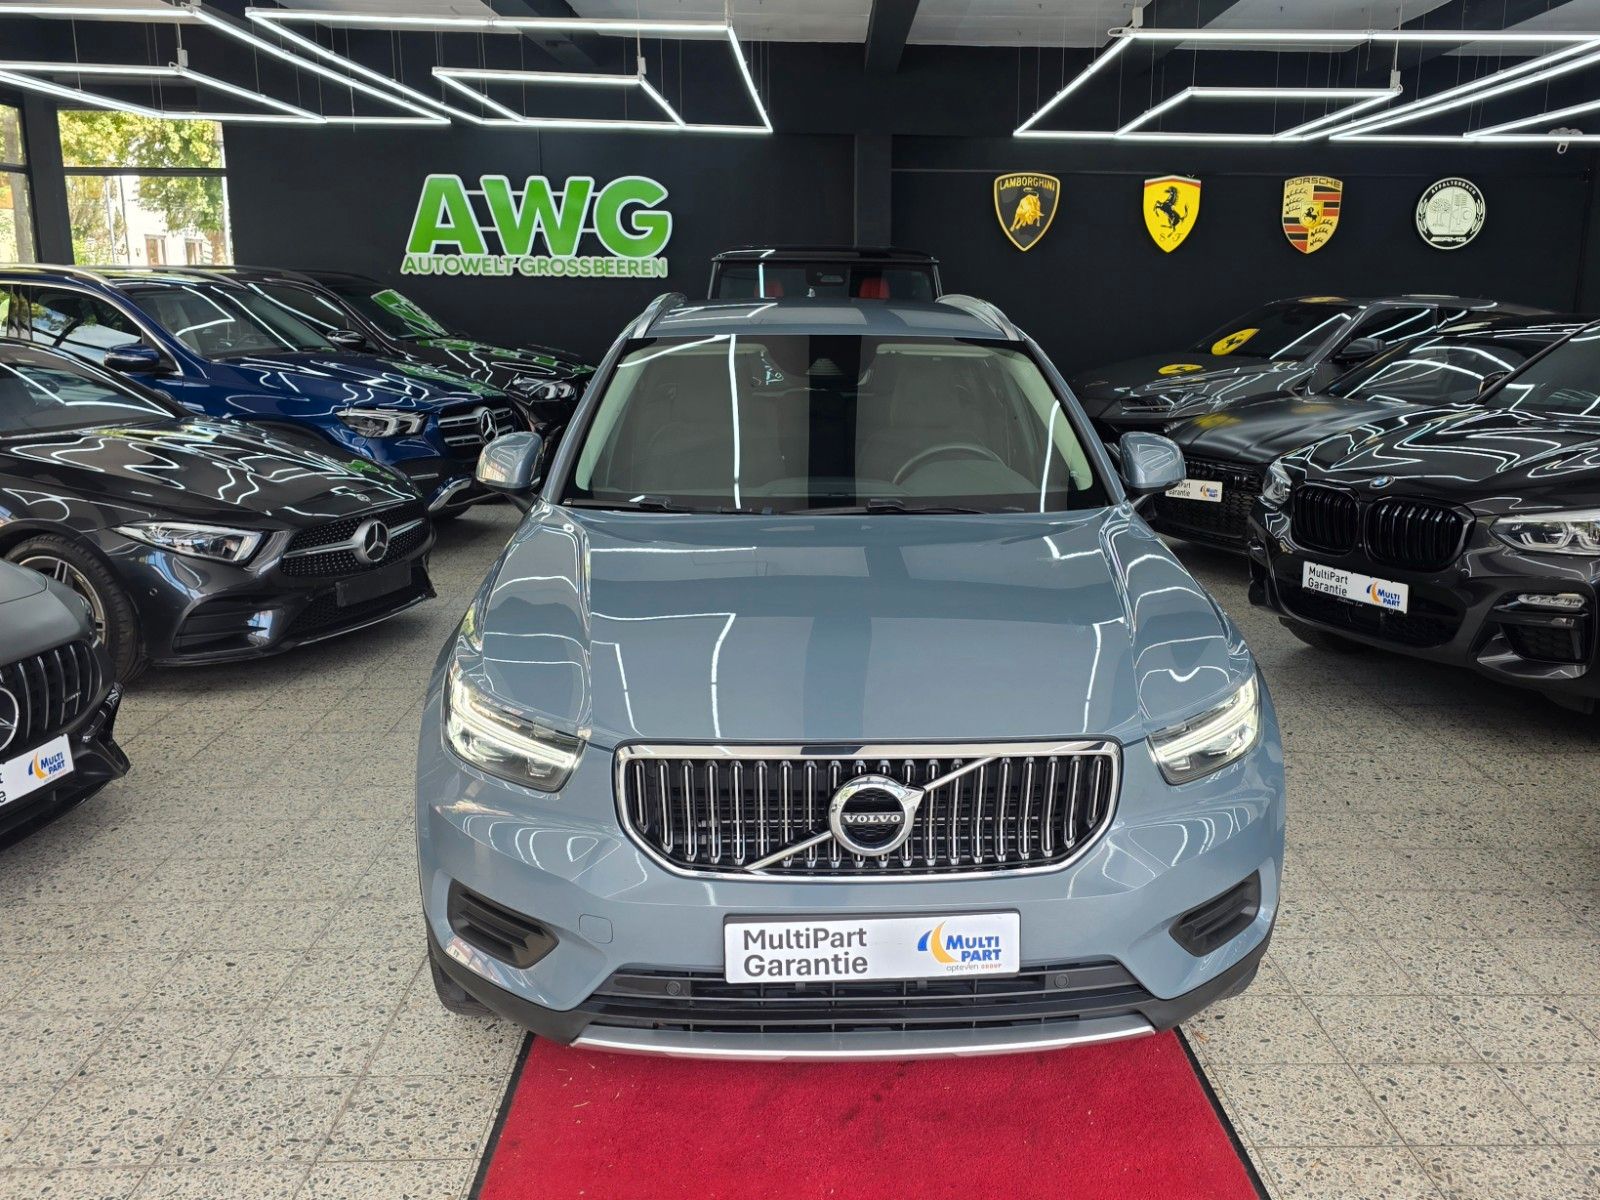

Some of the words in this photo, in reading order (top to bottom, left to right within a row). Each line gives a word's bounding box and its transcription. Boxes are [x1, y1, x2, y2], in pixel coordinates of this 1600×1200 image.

[1000, 176, 1056, 191] LAMBORGHINI
[1286, 177, 1341, 188] PORSCHE
[406, 174, 673, 258] AWG
[400, 255, 514, 276] AUTOWELT
[518, 255, 668, 278] GROSSBEEREN
[1308, 565, 1349, 585] MultiPart
[1307, 577, 1348, 597] Garantie
[1377, 588, 1401, 601] MULTI
[1382, 598, 1401, 607] PART
[40, 752, 64, 770] MULTI
[48, 760, 65, 775] PART
[843, 814, 902, 823] VOLVO
[743, 927, 868, 951] MultiPart
[945, 934, 1000, 951] MULTI
[961, 948, 1002, 963] PART
[743, 951, 869, 978] Garantie
[946, 961, 979, 973] opteven
